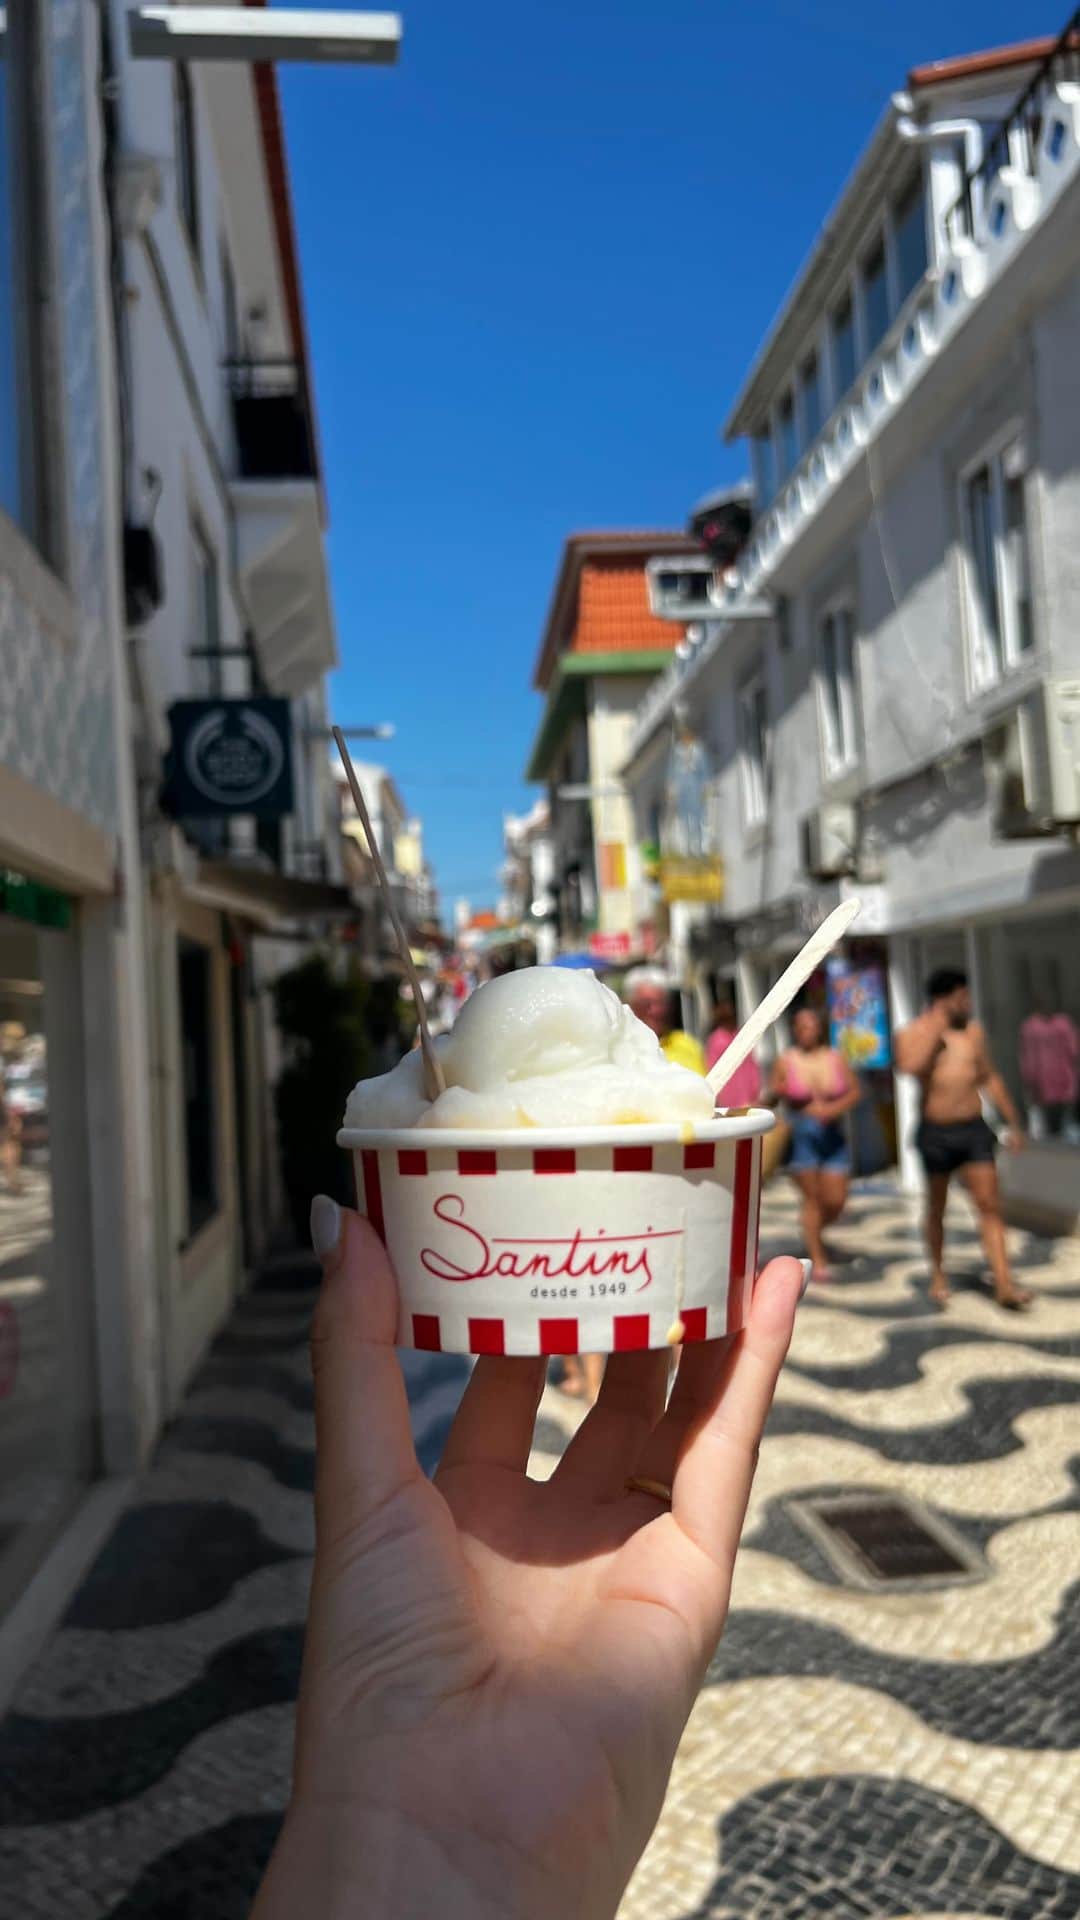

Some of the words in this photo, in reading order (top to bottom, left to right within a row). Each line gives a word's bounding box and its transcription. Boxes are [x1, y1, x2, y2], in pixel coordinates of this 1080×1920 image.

[420, 1194, 684, 1291] Santini
[530, 1285, 577, 1297] desde
[589, 1282, 626, 1296] 1949
